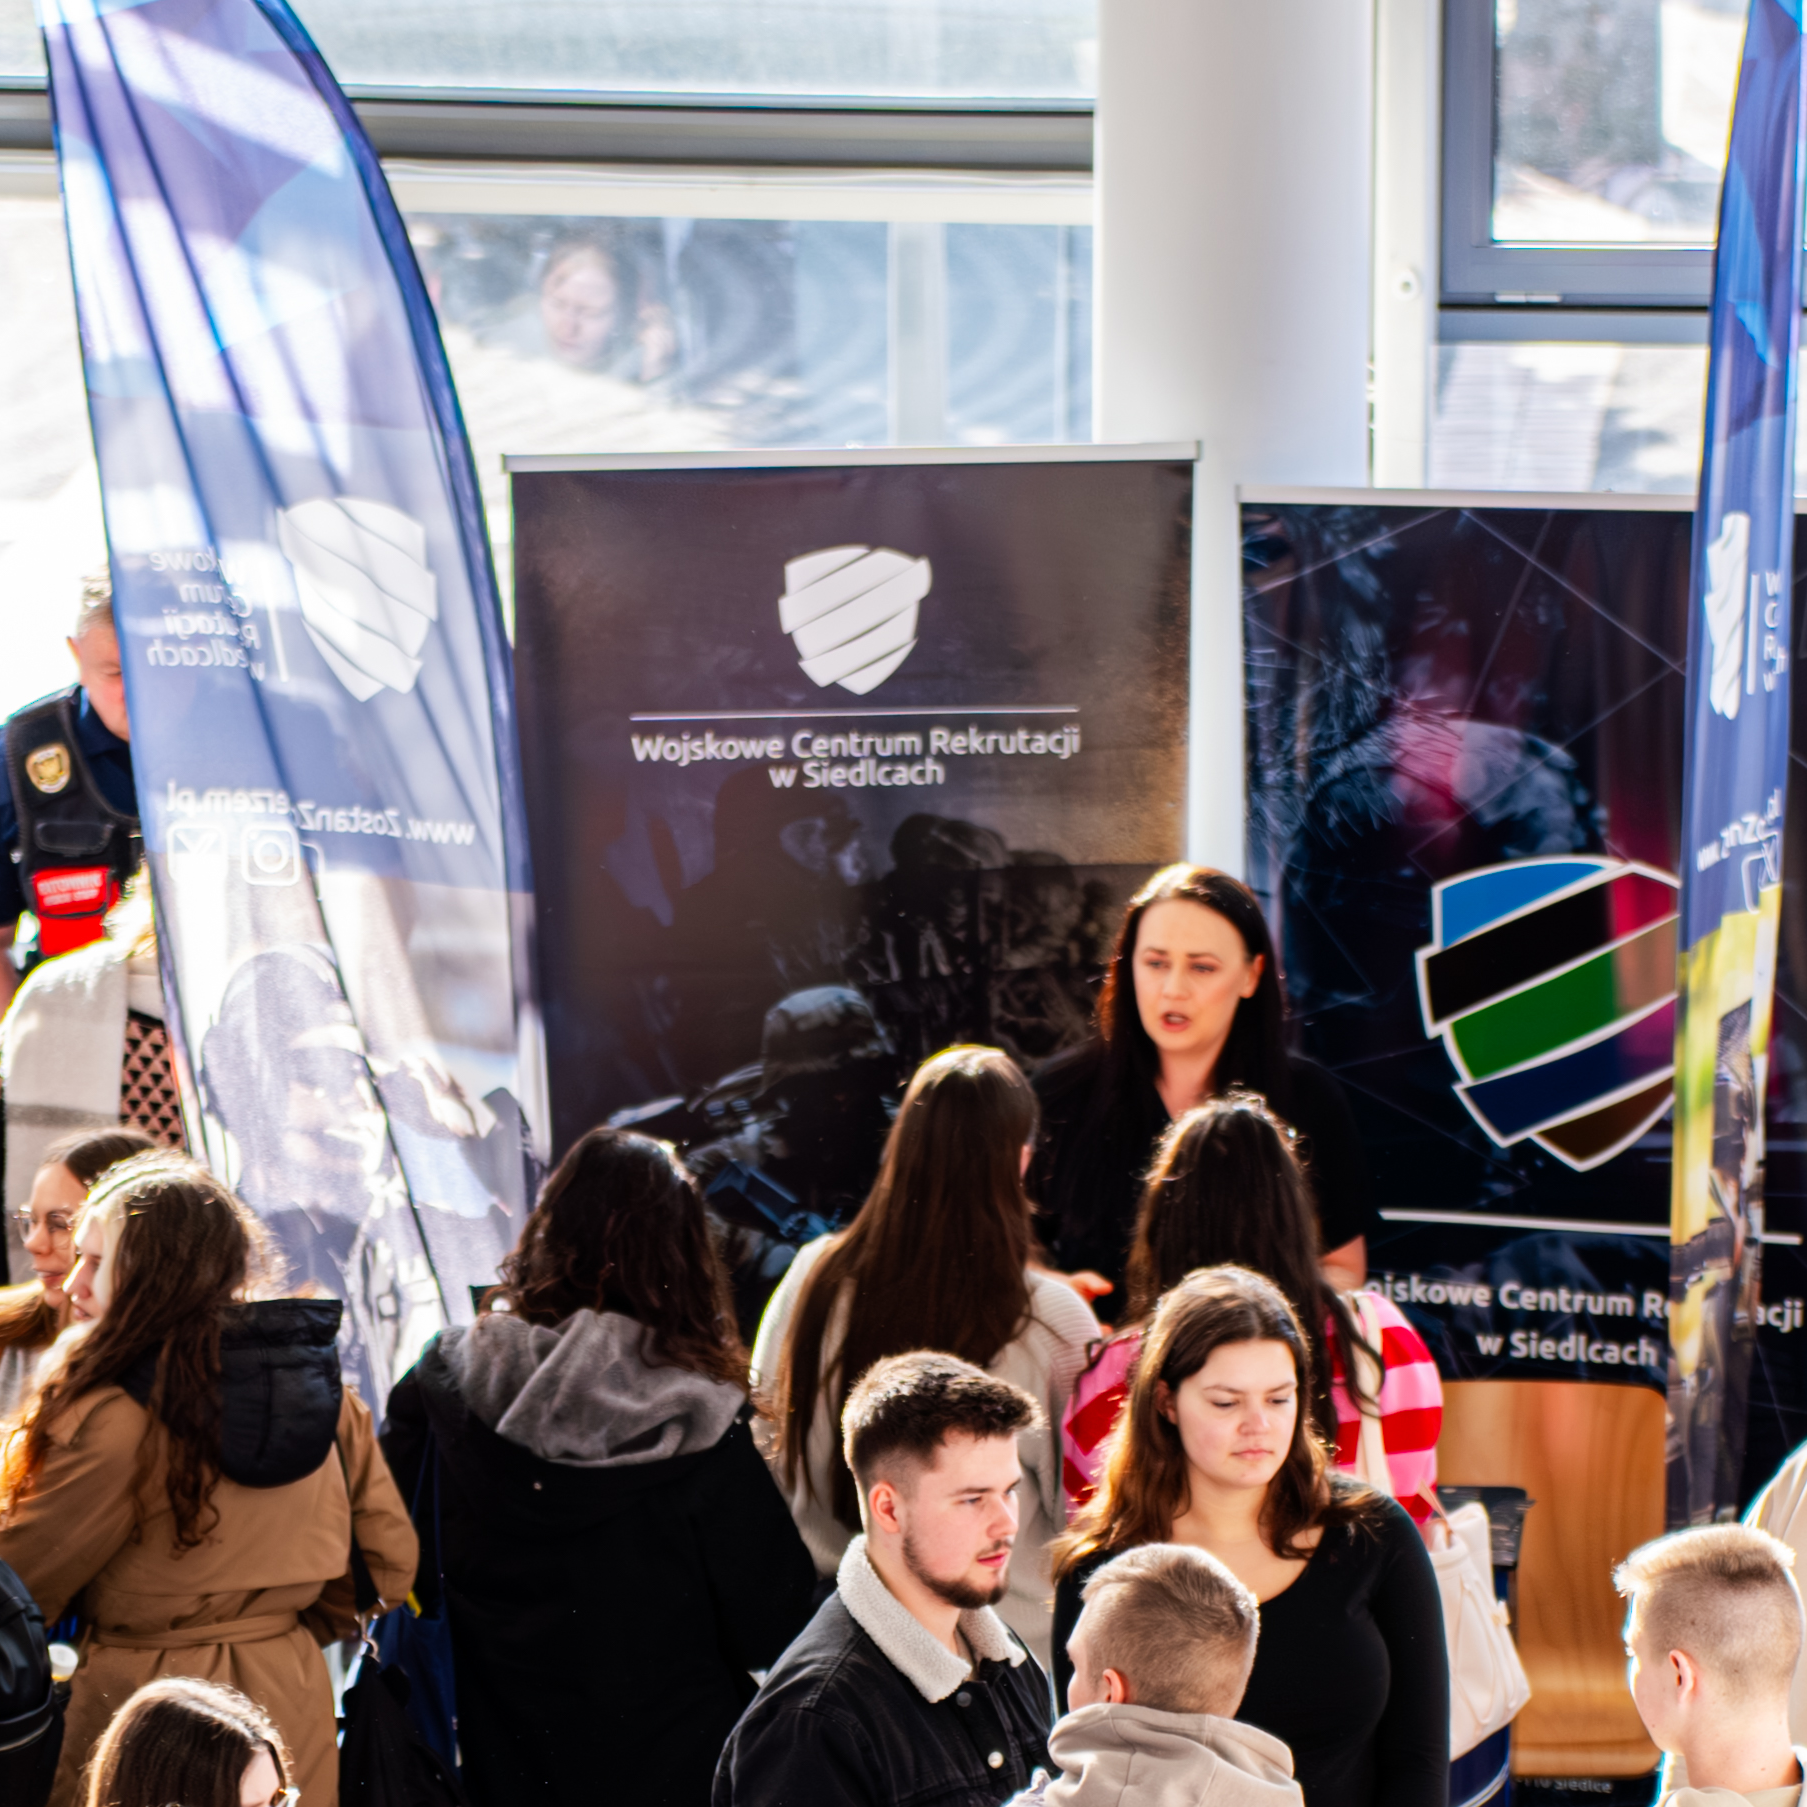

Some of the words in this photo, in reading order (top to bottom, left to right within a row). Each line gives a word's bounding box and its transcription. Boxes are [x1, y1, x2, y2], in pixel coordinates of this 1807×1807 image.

[630, 730, 784, 767] Wojskowe
[791, 729, 923, 760] Centrum
[929, 725, 1082, 762] Rekrutacji
[768, 765, 797, 788] w
[802, 757, 946, 788] Siedlcach
[1365, 1275, 1492, 1308] ojskowe
[1498, 1282, 1635, 1318] Centrum
[1476, 1333, 1503, 1356] w
[1510, 1331, 1659, 1367] Siedlcach
